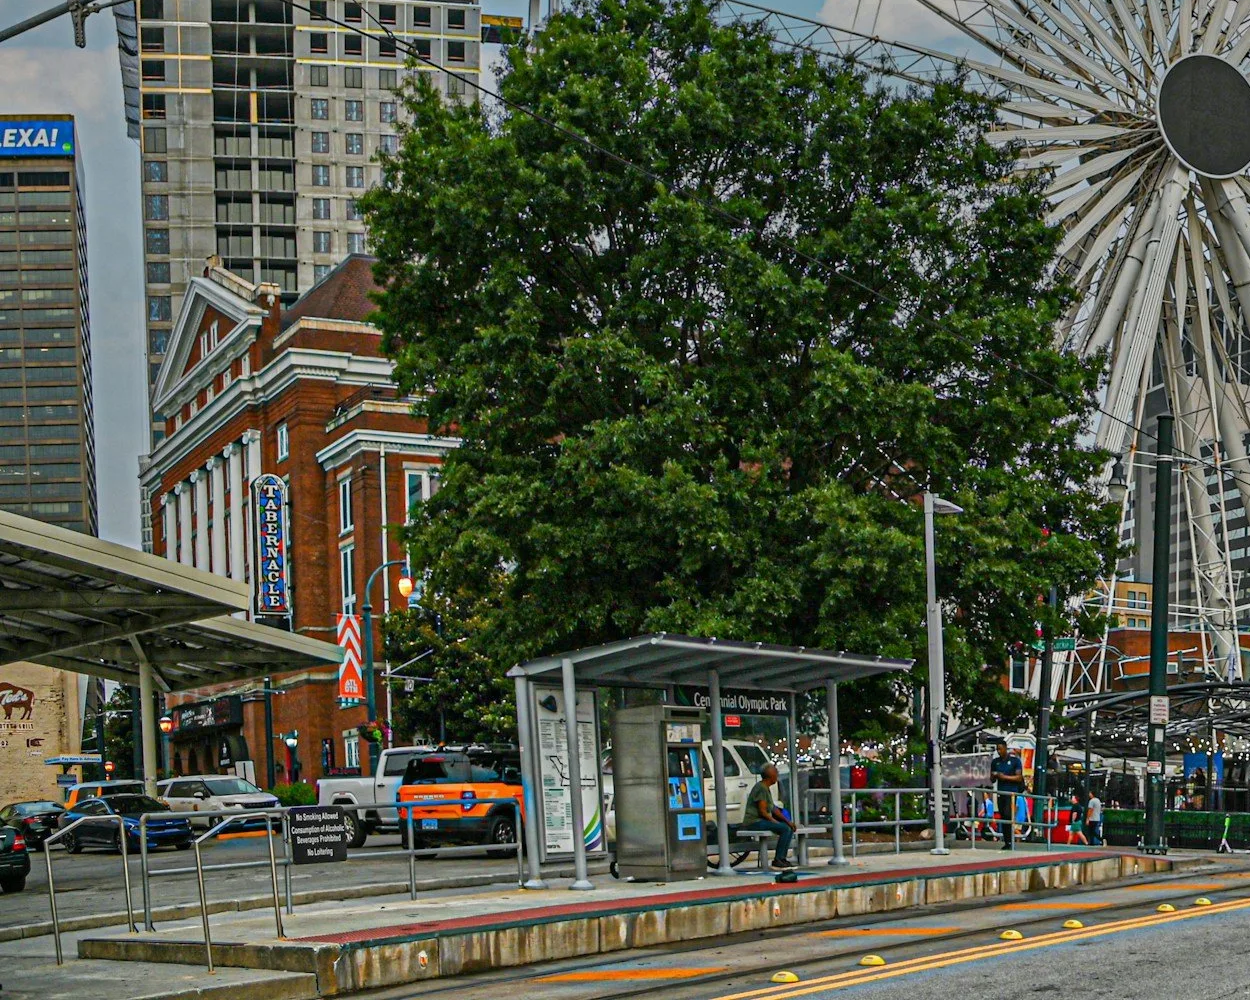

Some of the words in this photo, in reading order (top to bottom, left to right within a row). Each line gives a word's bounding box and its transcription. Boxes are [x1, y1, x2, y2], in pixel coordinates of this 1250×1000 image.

[0, 128, 59, 148] EXA!
[262, 484, 281, 608] TABERNACLE
[738, 695, 768, 713] Olympic
[770, 697, 787, 711] Park
[303, 813, 322, 822] Smoking
[322, 812, 339, 820] Allowed
[291, 825, 320, 835] Consumption
[320, 824, 326, 832] of
[326, 823, 345, 831] Alcoholic
[296, 835, 320, 845] Beverages
[319, 834, 342, 842] Prohibited
[307, 848, 315, 856] No
[314, 847, 334, 857] Loitering
